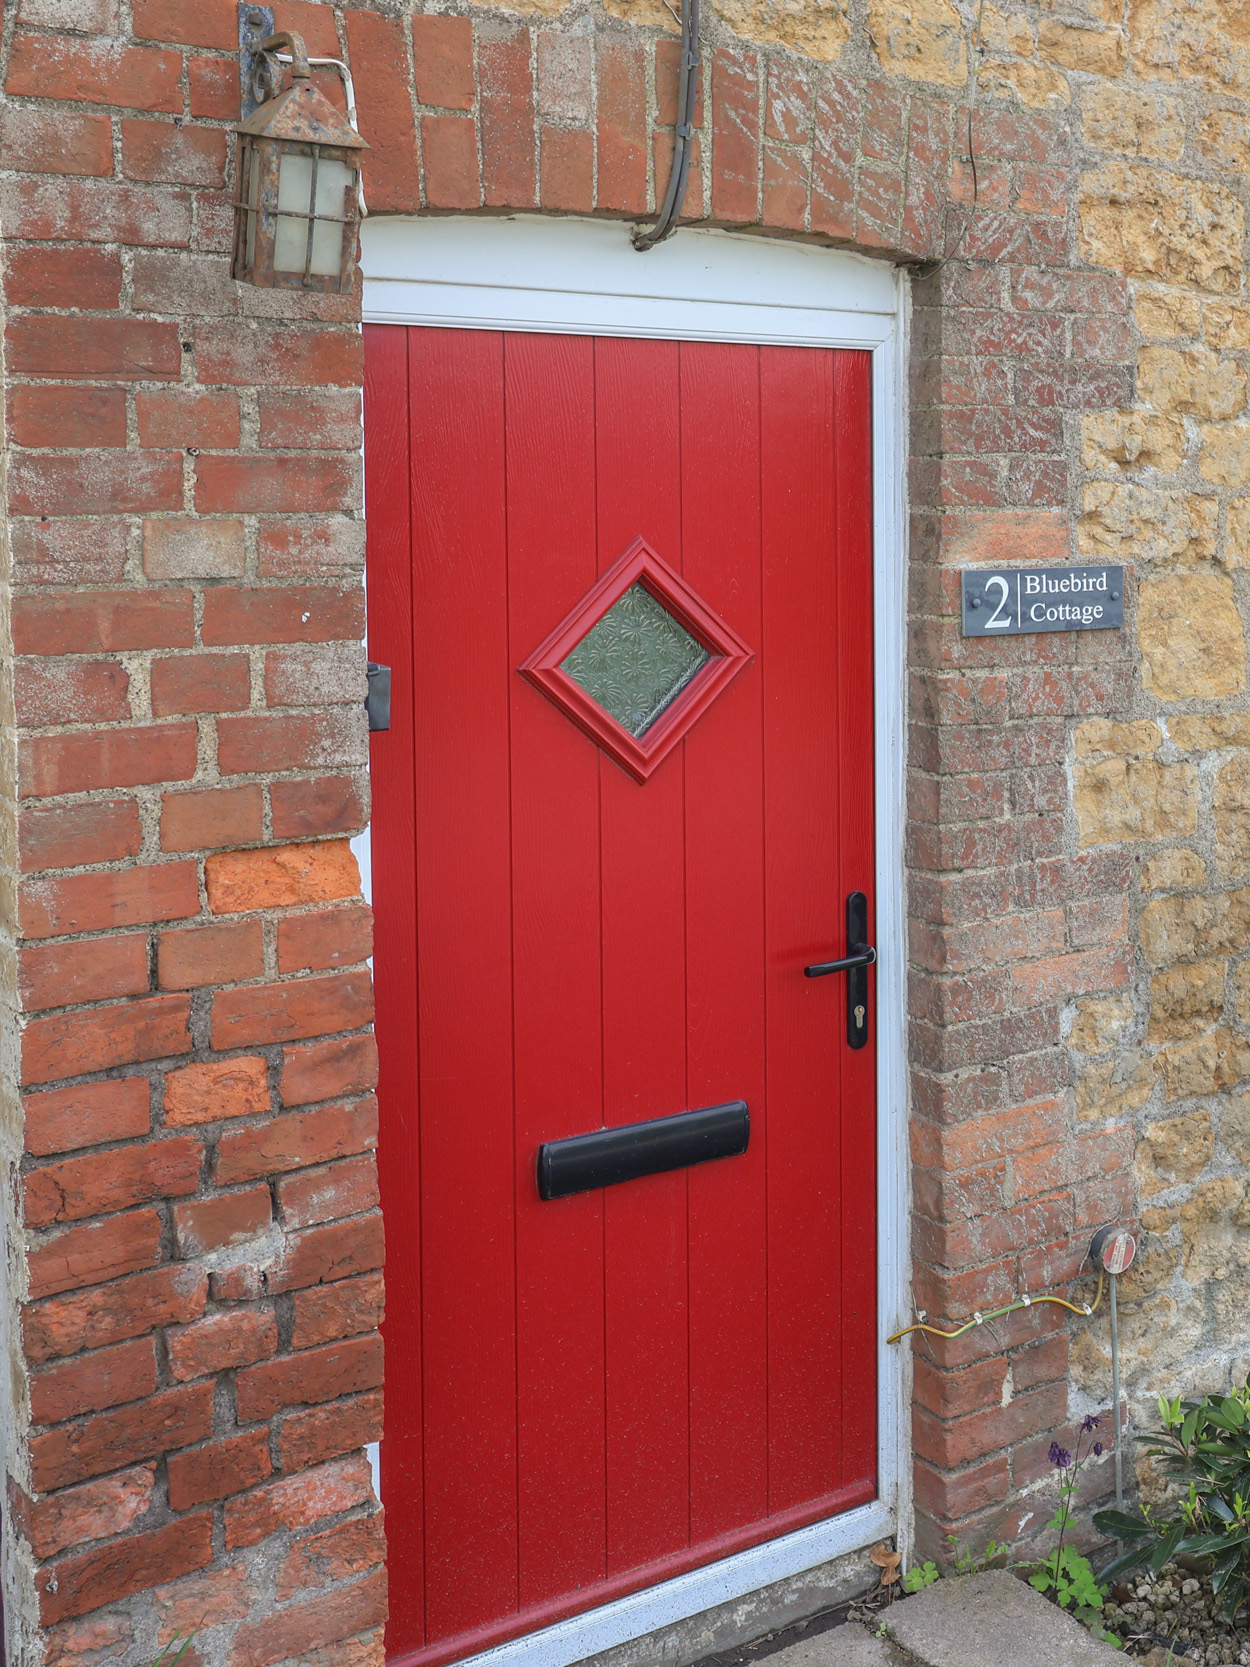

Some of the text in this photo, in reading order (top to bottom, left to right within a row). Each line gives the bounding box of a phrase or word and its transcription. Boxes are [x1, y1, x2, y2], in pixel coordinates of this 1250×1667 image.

[1025, 572, 1108, 594] Bluebird
[984, 576, 1012, 629] 2
[1030, 603, 1104, 624] Cottage
